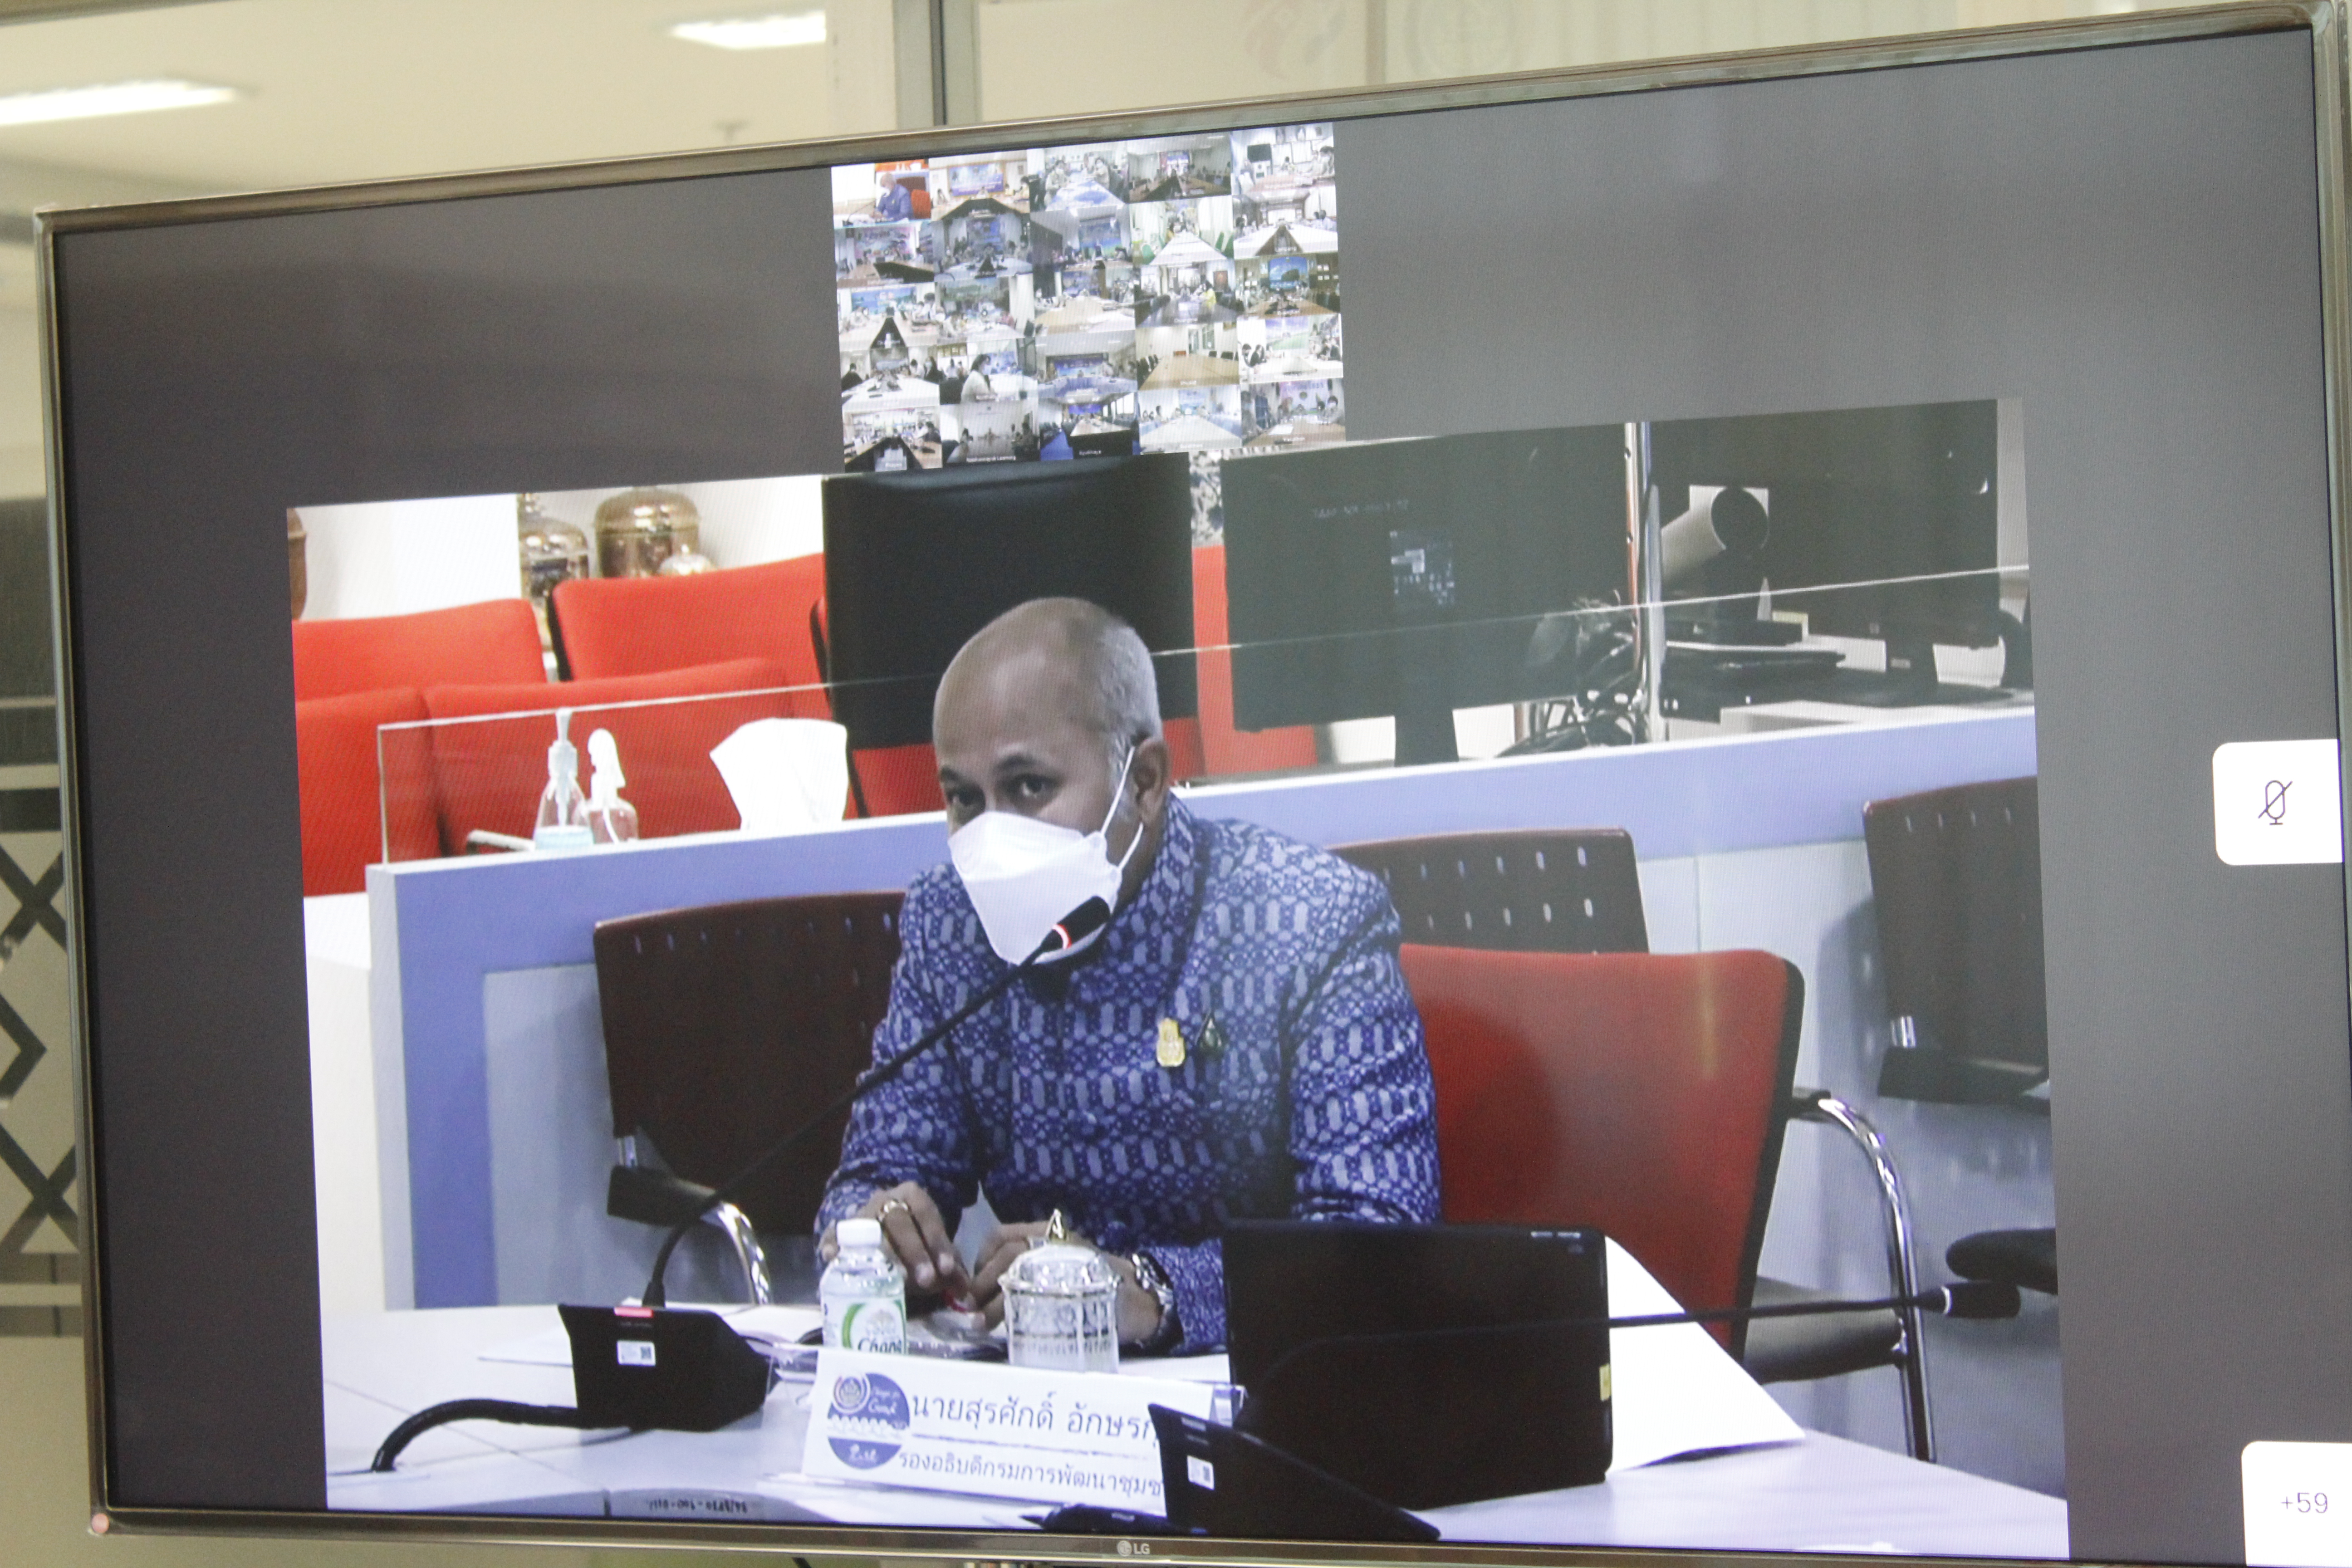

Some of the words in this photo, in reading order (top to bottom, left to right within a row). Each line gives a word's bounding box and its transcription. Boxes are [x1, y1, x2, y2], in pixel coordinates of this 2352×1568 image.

[913, 1391, 1056, 1431] นายสุรศักดิ์
[2281, 1492, 2328, 1514] +59
[1133, 1543, 1150, 1554] LG
